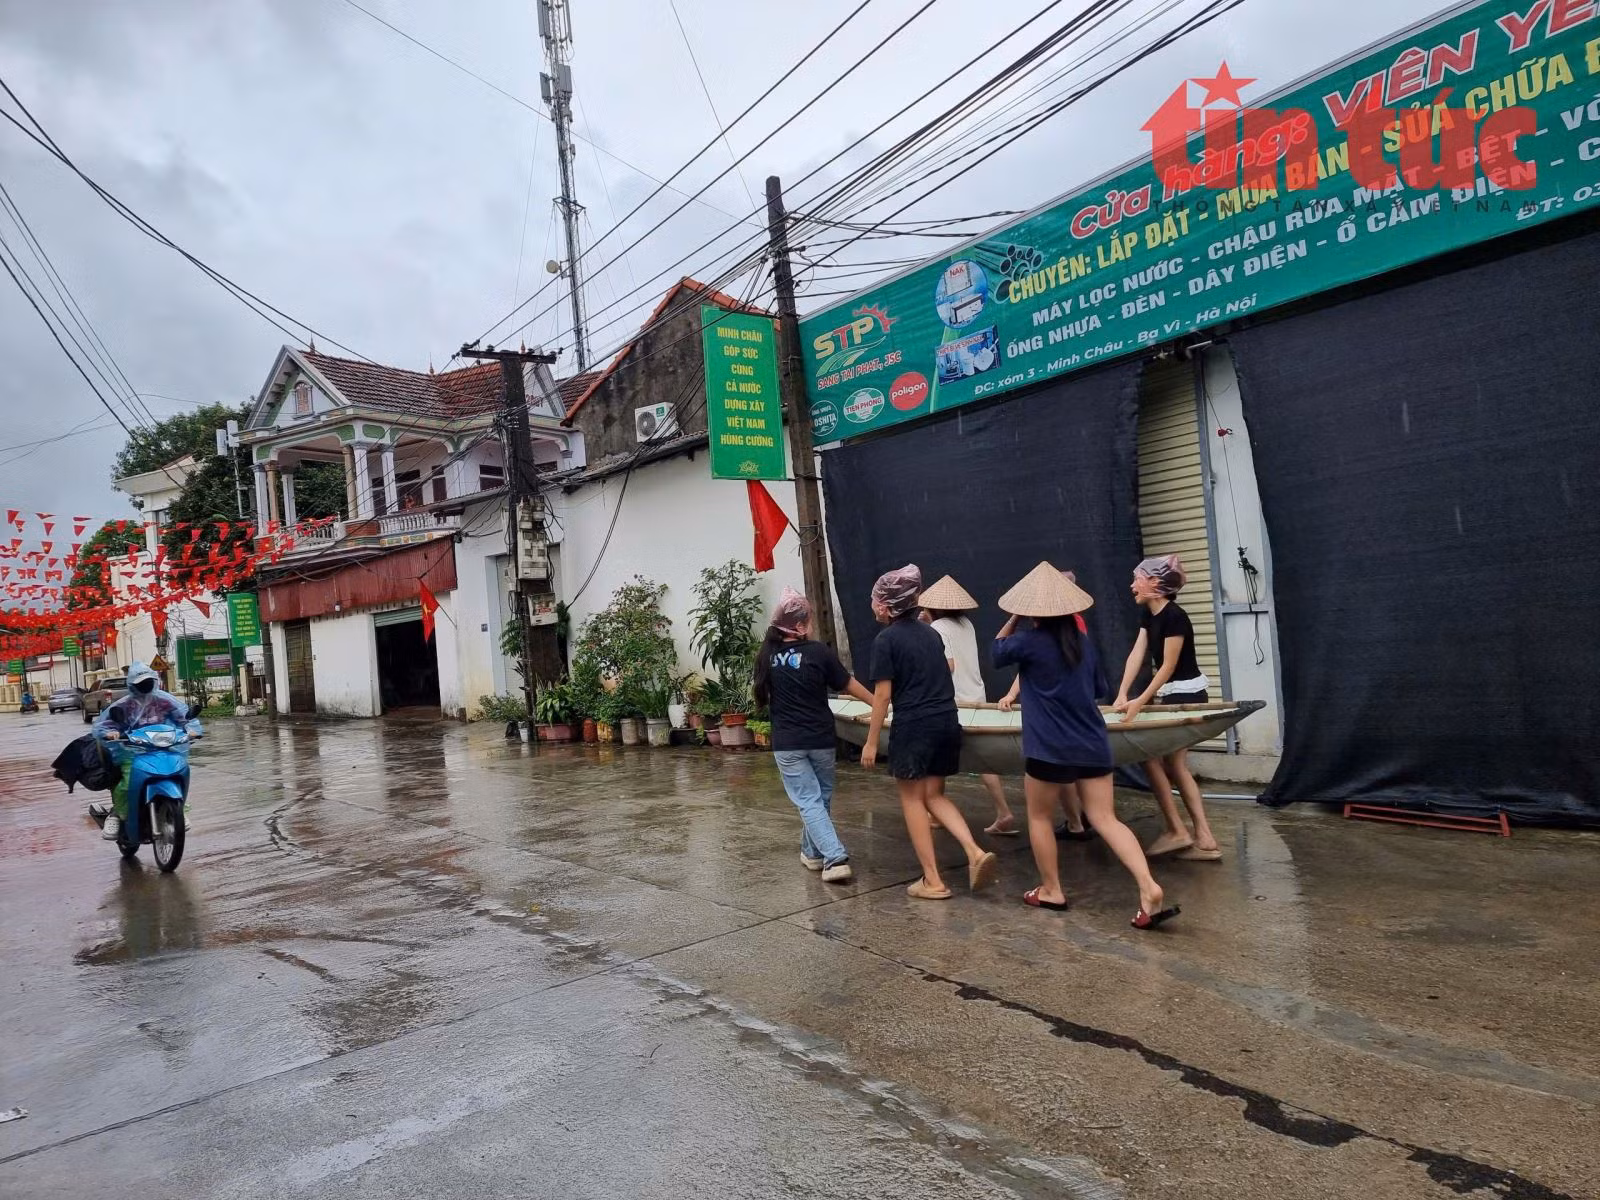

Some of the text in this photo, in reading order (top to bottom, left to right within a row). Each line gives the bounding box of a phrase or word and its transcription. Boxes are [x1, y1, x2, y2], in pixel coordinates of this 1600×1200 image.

[1070, 184, 1152, 240] Cửa
[1162, 112, 1311, 203] hàng:
[1321, 27, 1480, 127] VIÊN
[1008, 252, 1092, 304] CHUYÊN:
[1096, 229, 1139, 269] LẮP
[1144, 208, 1190, 249] ĐẶT
[1216, 174, 1279, 221] MUA
[1285, 141, 1350, 193] BÁN
[1464, 53, 1575, 121] CHỮA
[1032, 299, 1073, 327] MÁY
[1079, 282, 1117, 309] LỌC
[1122, 256, 1184, 293] NƯỚC
[1207, 221, 1277, 260] CHẬU
[1285, 197, 1345, 233] RỬA
[1352, 165, 1422, 208] MẶT
[1456, 129, 1521, 171] BỆT
[1006, 338, 1044, 359] ỐNG
[1048, 314, 1102, 346] NHỰA
[1121, 290, 1166, 320] ĐÈN
[1188, 264, 1236, 296] DÂY
[1243, 239, 1308, 277] ĐIỆN
[1336, 214, 1357, 243] Ổ
[1450, 159, 1537, 204] ĐIỆN
[974, 382, 995, 395] ĐC:
[998, 373, 1025, 388] xóm
[1027, 369, 1035, 378] 3
[1047, 355, 1080, 373] Minh
[1084, 340, 1123, 359] Châu
[1163, 319, 1181, 334] Vì
[1195, 307, 1221, 324] Hà
[1225, 293, 1258, 314] Nội
[1516, 196, 1565, 220] ĐT:
[716, 326, 763, 343] MINH CHÂU
[813, 316, 874, 360] STP
[723, 344, 741, 357] GÓP
[884, 350, 902, 367] JSC
[739, 380, 762, 394] NƯỚC
[891, 382, 928, 401] poligon
[749, 399, 765, 412] XÂY
[860, 397, 883, 410] PHONG
[726, 416, 766, 430] VIỆT NAM
[720, 432, 774, 448] HÙNG CƯỜNG
